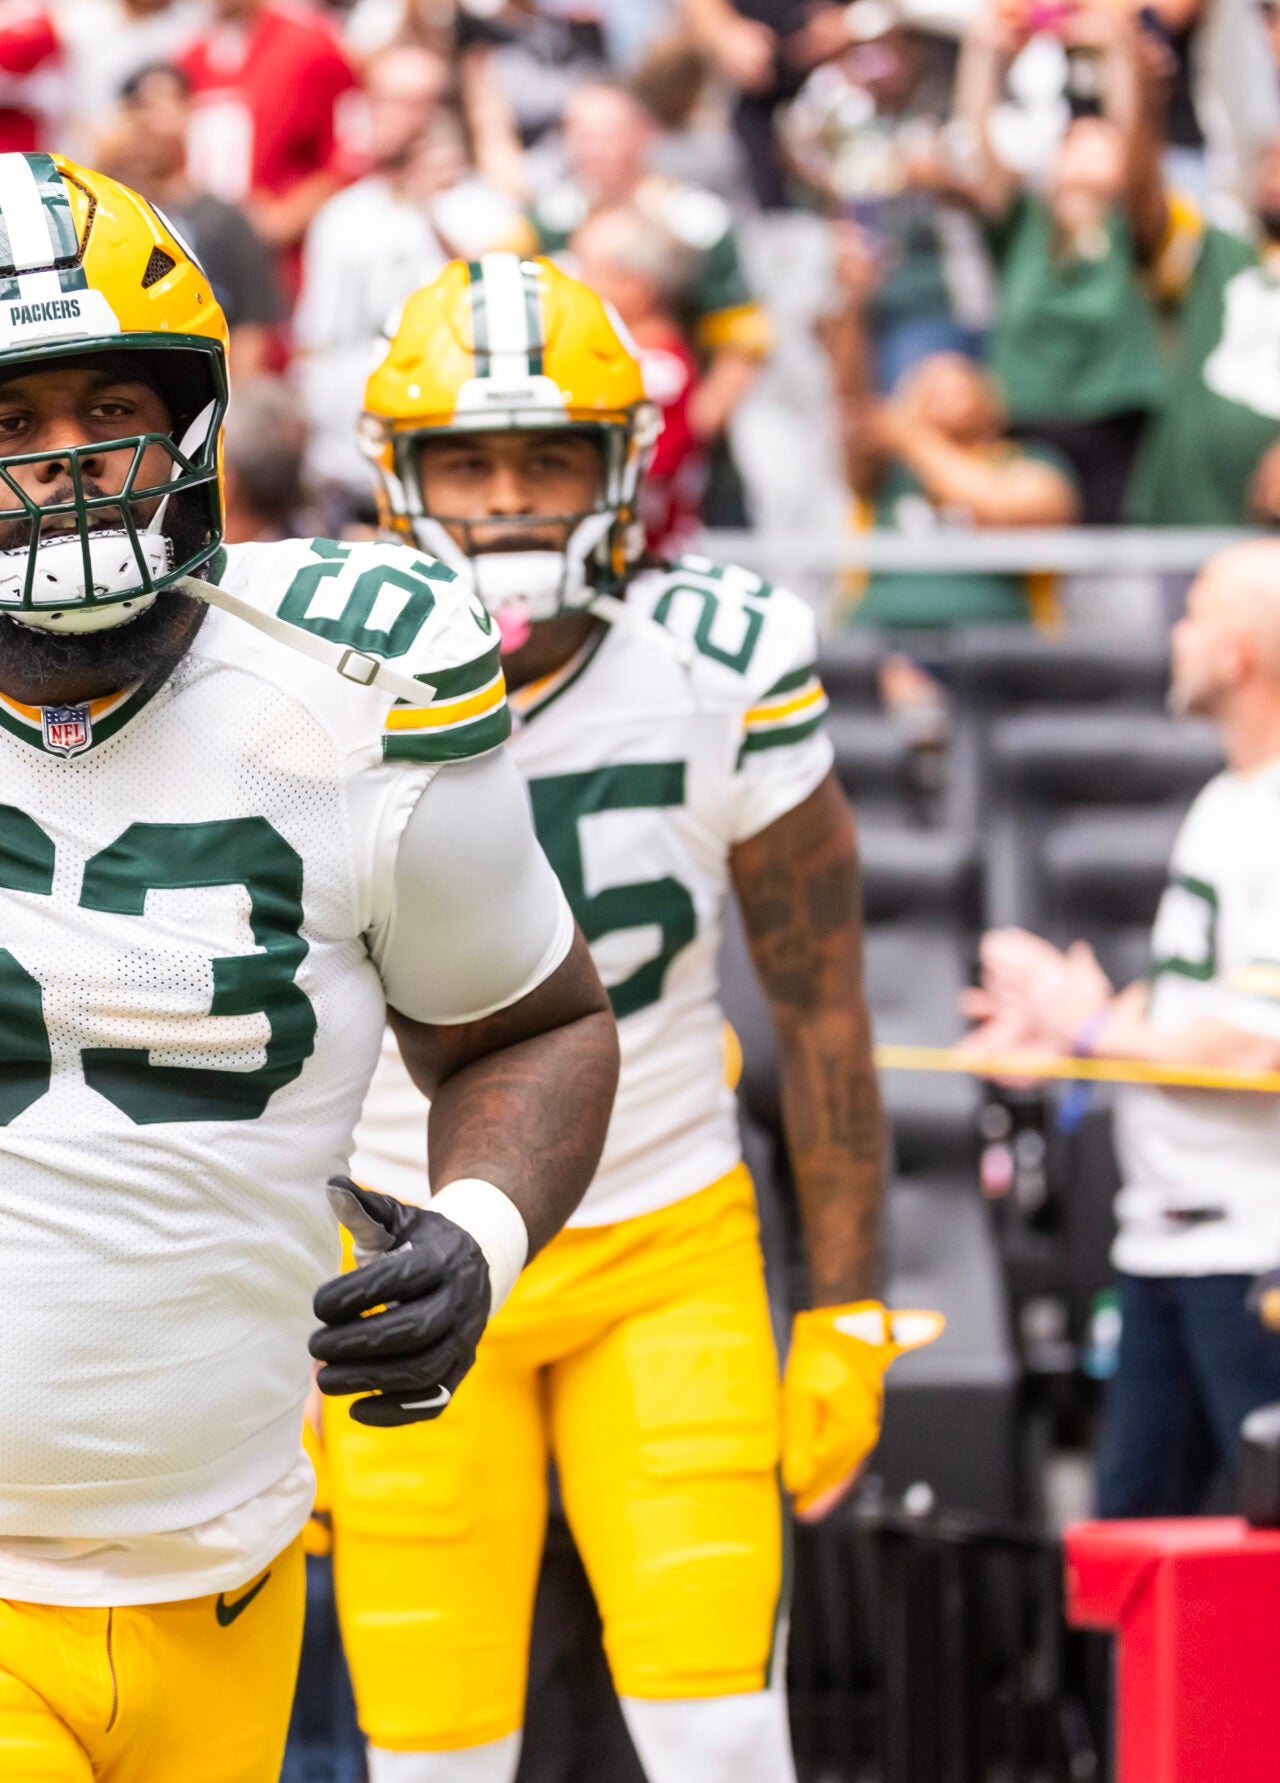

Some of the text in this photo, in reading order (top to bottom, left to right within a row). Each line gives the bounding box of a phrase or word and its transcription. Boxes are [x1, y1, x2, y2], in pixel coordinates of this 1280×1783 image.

[10, 299, 81, 326] PACKERS
[51, 723, 84, 746] NFL
[528, 761, 696, 1018] 5
